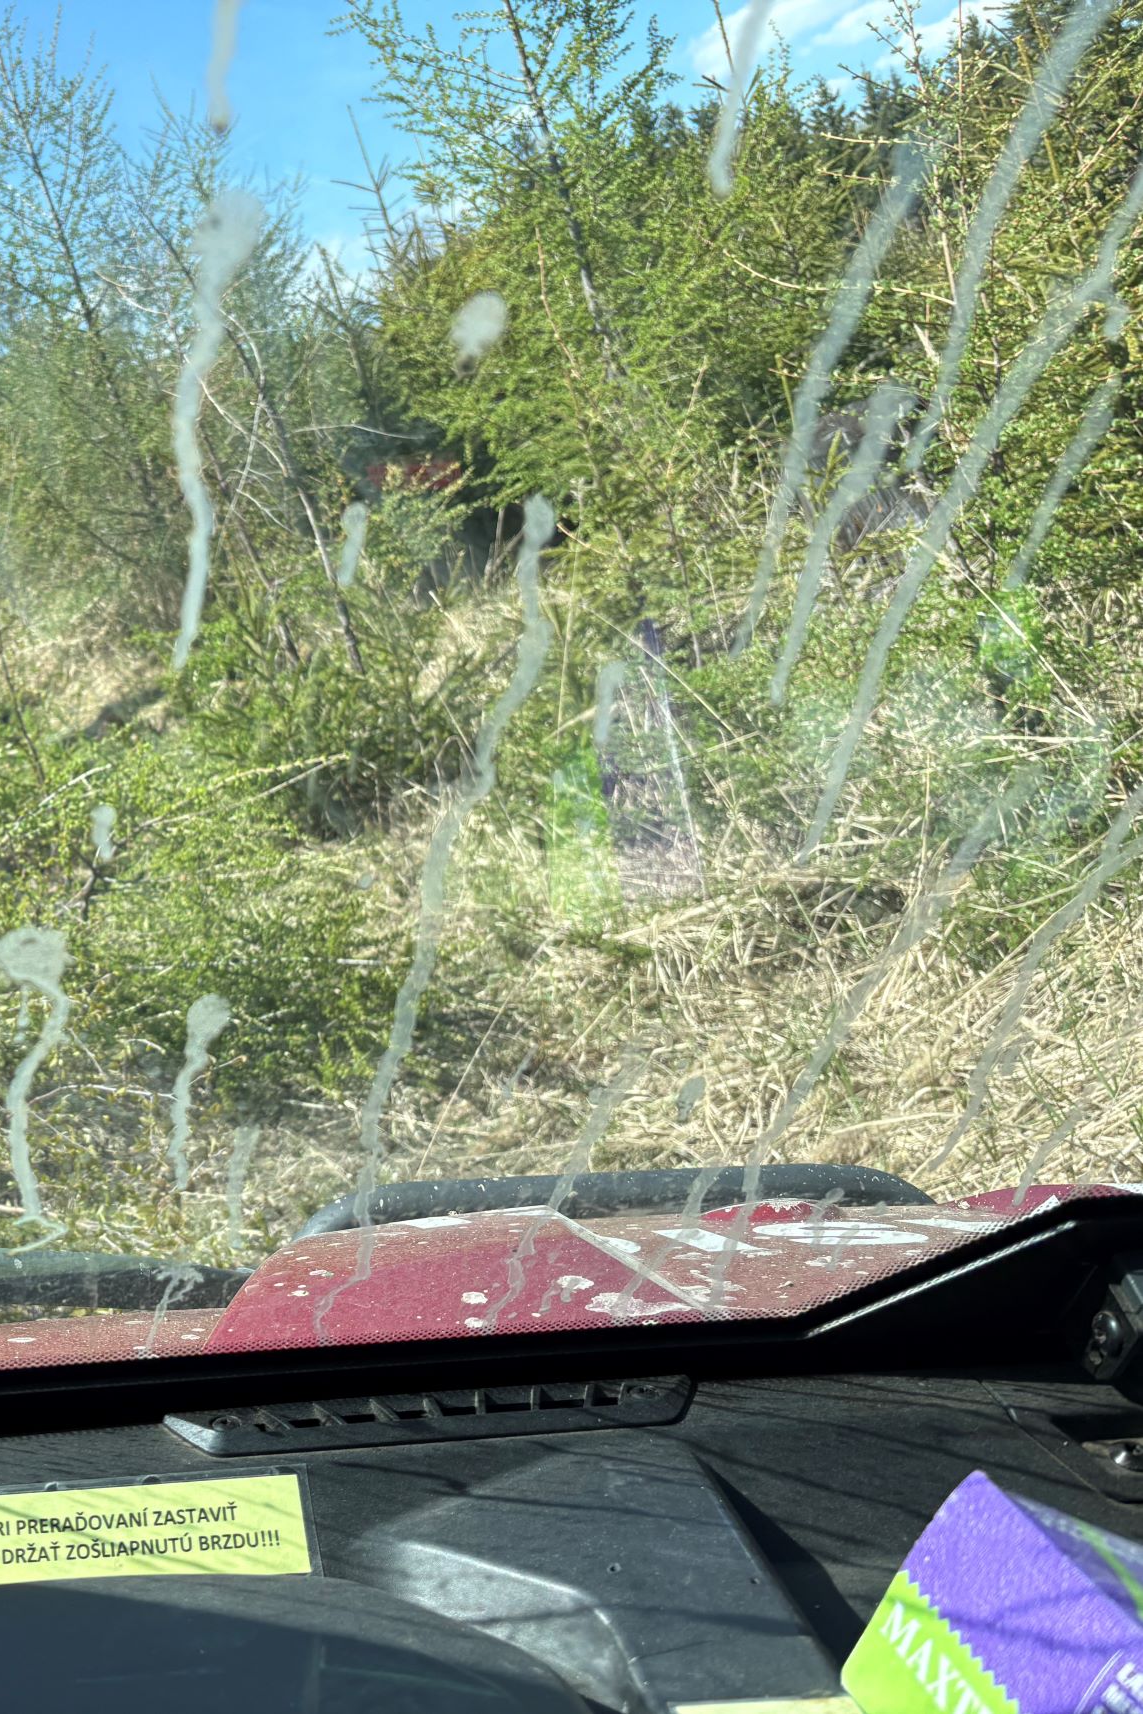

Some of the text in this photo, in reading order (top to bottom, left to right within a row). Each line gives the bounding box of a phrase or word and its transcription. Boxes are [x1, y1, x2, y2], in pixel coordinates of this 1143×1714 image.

[16, 1507, 148, 1535] PRERAĎOVANÍ
[152, 1501, 238, 1526] ZASTAVIŤ
[1, 1541, 61, 1564] DRŽAŤ
[65, 1532, 193, 1560] ZOŠLIAPNUTÚ
[198, 1529, 280, 1551] BRZDU!!!
[879, 1600, 994, 1714] MAXT
